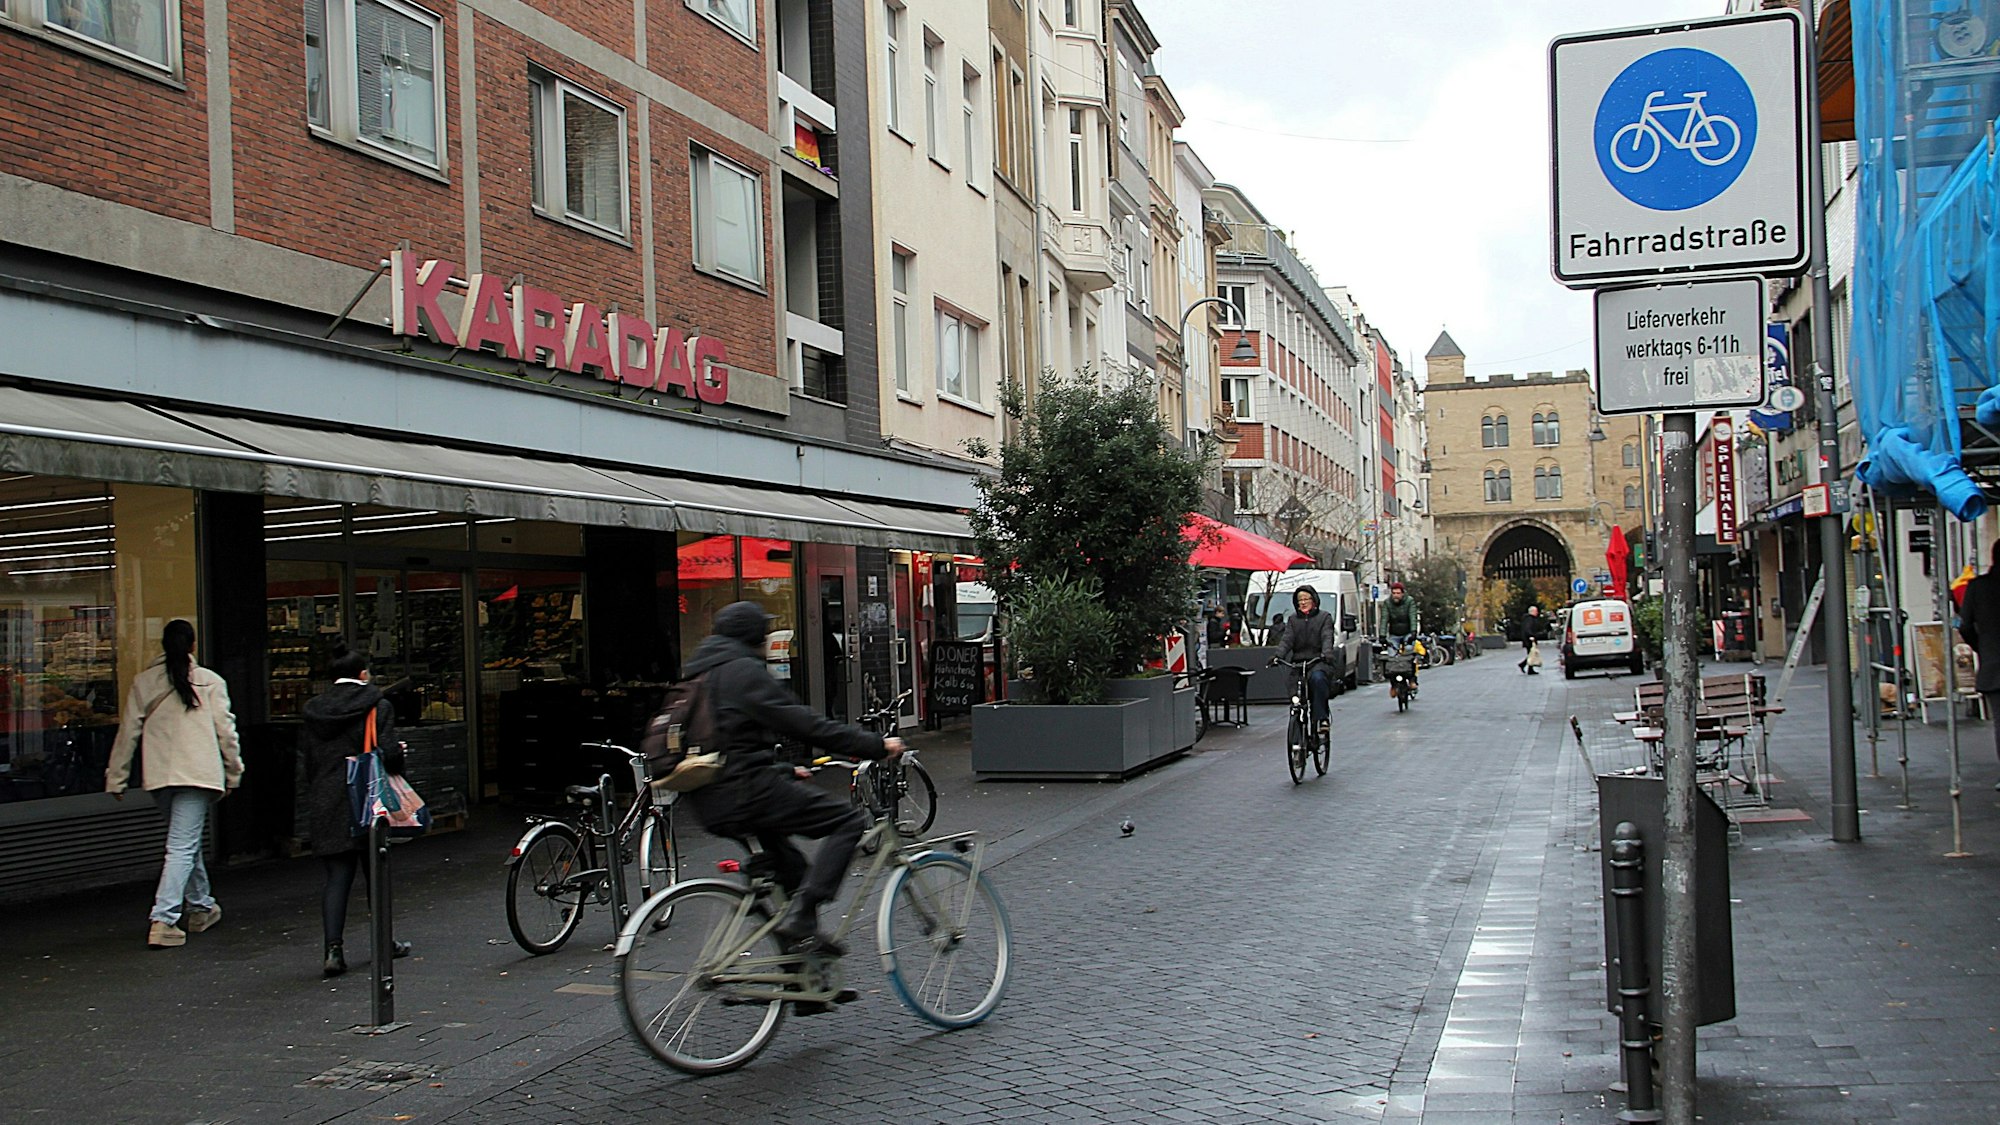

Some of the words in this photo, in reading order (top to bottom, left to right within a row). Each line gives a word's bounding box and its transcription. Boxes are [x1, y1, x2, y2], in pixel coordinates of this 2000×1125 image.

[1570, 219, 1787, 259] Fahrradstraße
[390, 250, 728, 405] KARADAG
[1627, 306, 1726, 330] Lieferverkehr
[1626, 339, 1692, 359] werktags
[1698, 334, 1740, 355] 6-11h
[1663, 366, 1689, 386] frei
[1717, 444, 1734, 540] SPIELHALLE
[934, 675, 958, 689] Kalb
[935, 691, 960, 706] Vegan
